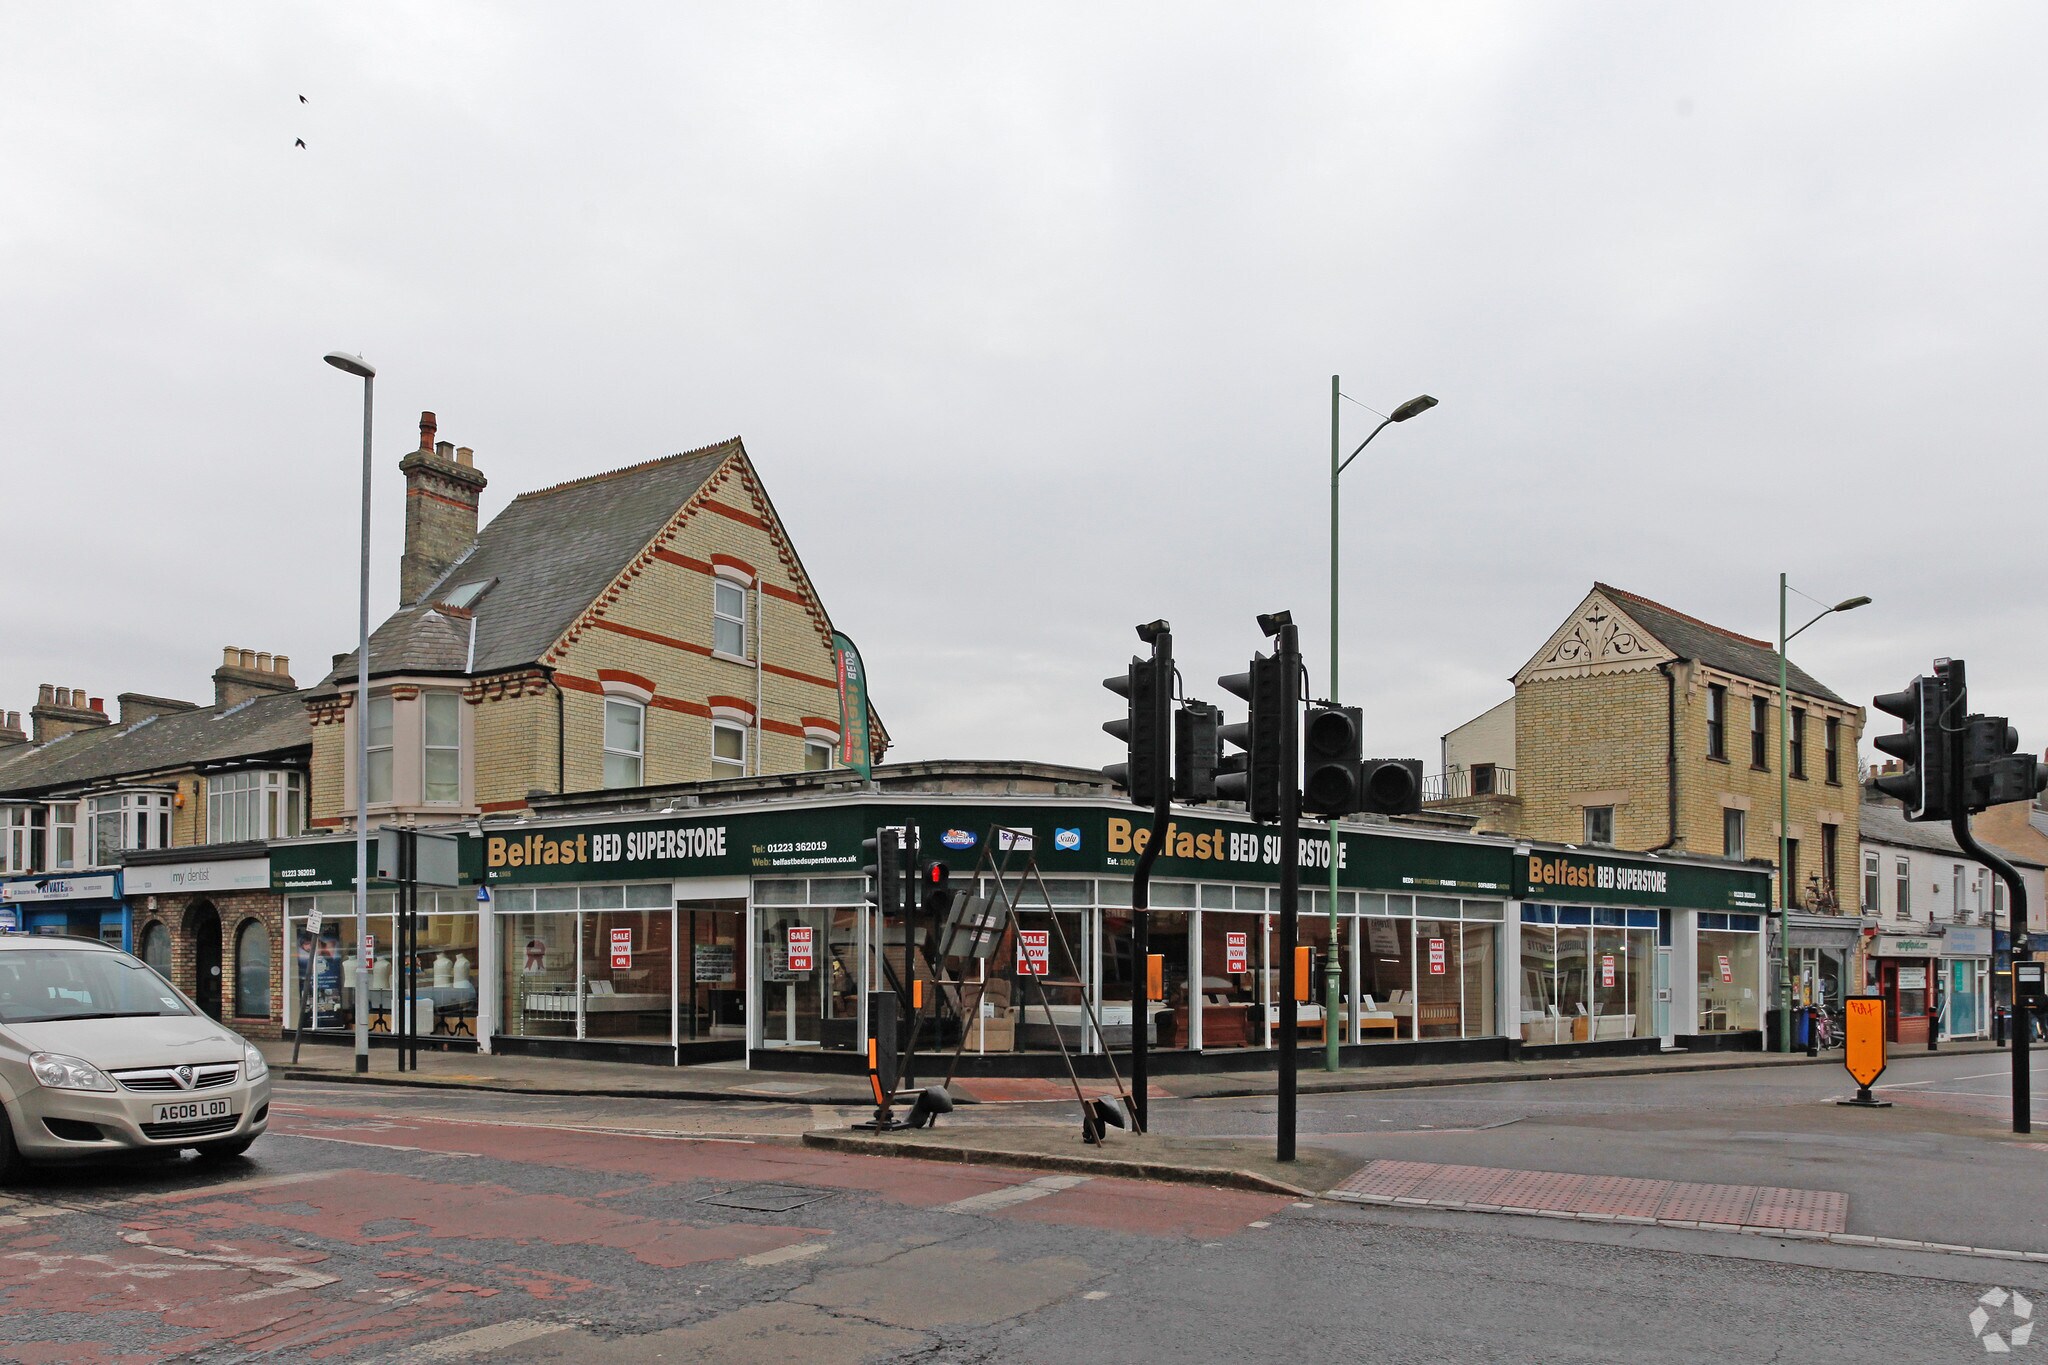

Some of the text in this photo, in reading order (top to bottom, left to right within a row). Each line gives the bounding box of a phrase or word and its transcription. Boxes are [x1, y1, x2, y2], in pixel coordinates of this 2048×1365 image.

[943, 836, 975, 844] Silentnight
[1060, 834, 1077, 845] Sealy
[1108, 818, 1346, 869] Befast BED SURSTOE
[488, 827, 726, 867] Belfast BED SUPERSTORE
[752, 841, 827, 853] Tel: 01223 362019
[752, 855, 856, 866] Web: belfastbedsuperstore.co.uk
[173, 868, 209, 885] my dentist
[1529, 856, 1666, 892] Belfast BED SUPERSTORE
[613, 932, 628, 941] SALE
[1022, 936, 1045, 944] SALE
[795, 959, 806, 967] ON
[160, 1104, 197, 1120] AG08
